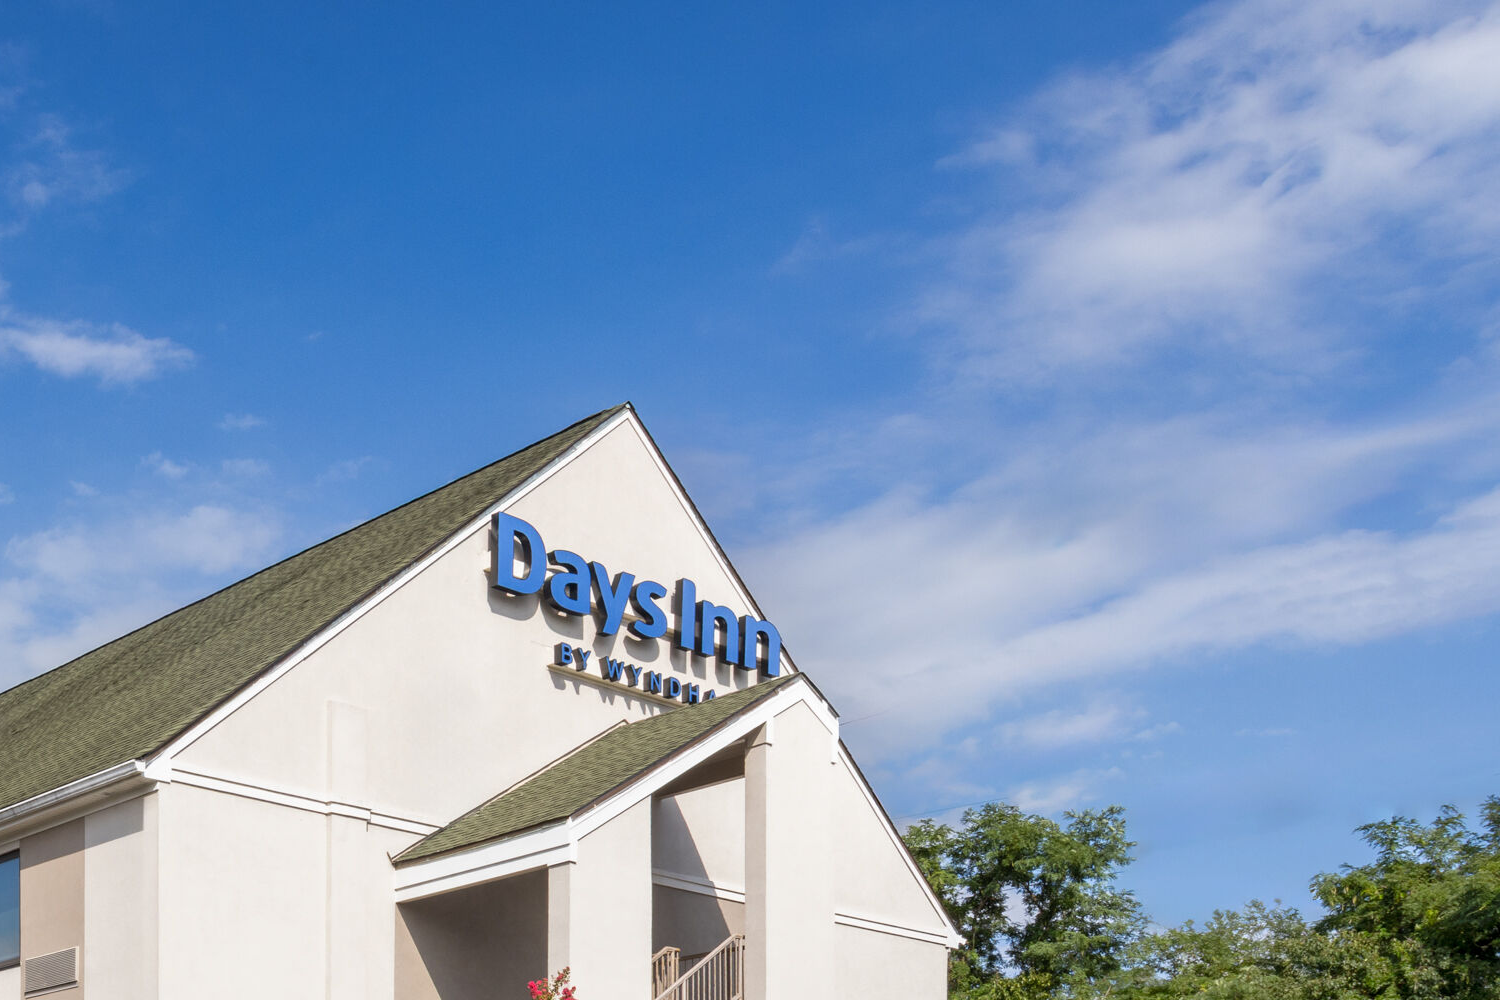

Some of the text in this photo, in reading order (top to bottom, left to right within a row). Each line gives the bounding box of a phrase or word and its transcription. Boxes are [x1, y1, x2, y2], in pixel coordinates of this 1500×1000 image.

[492, 511, 781, 677] Days Inn
[557, 642, 591, 670] BY
